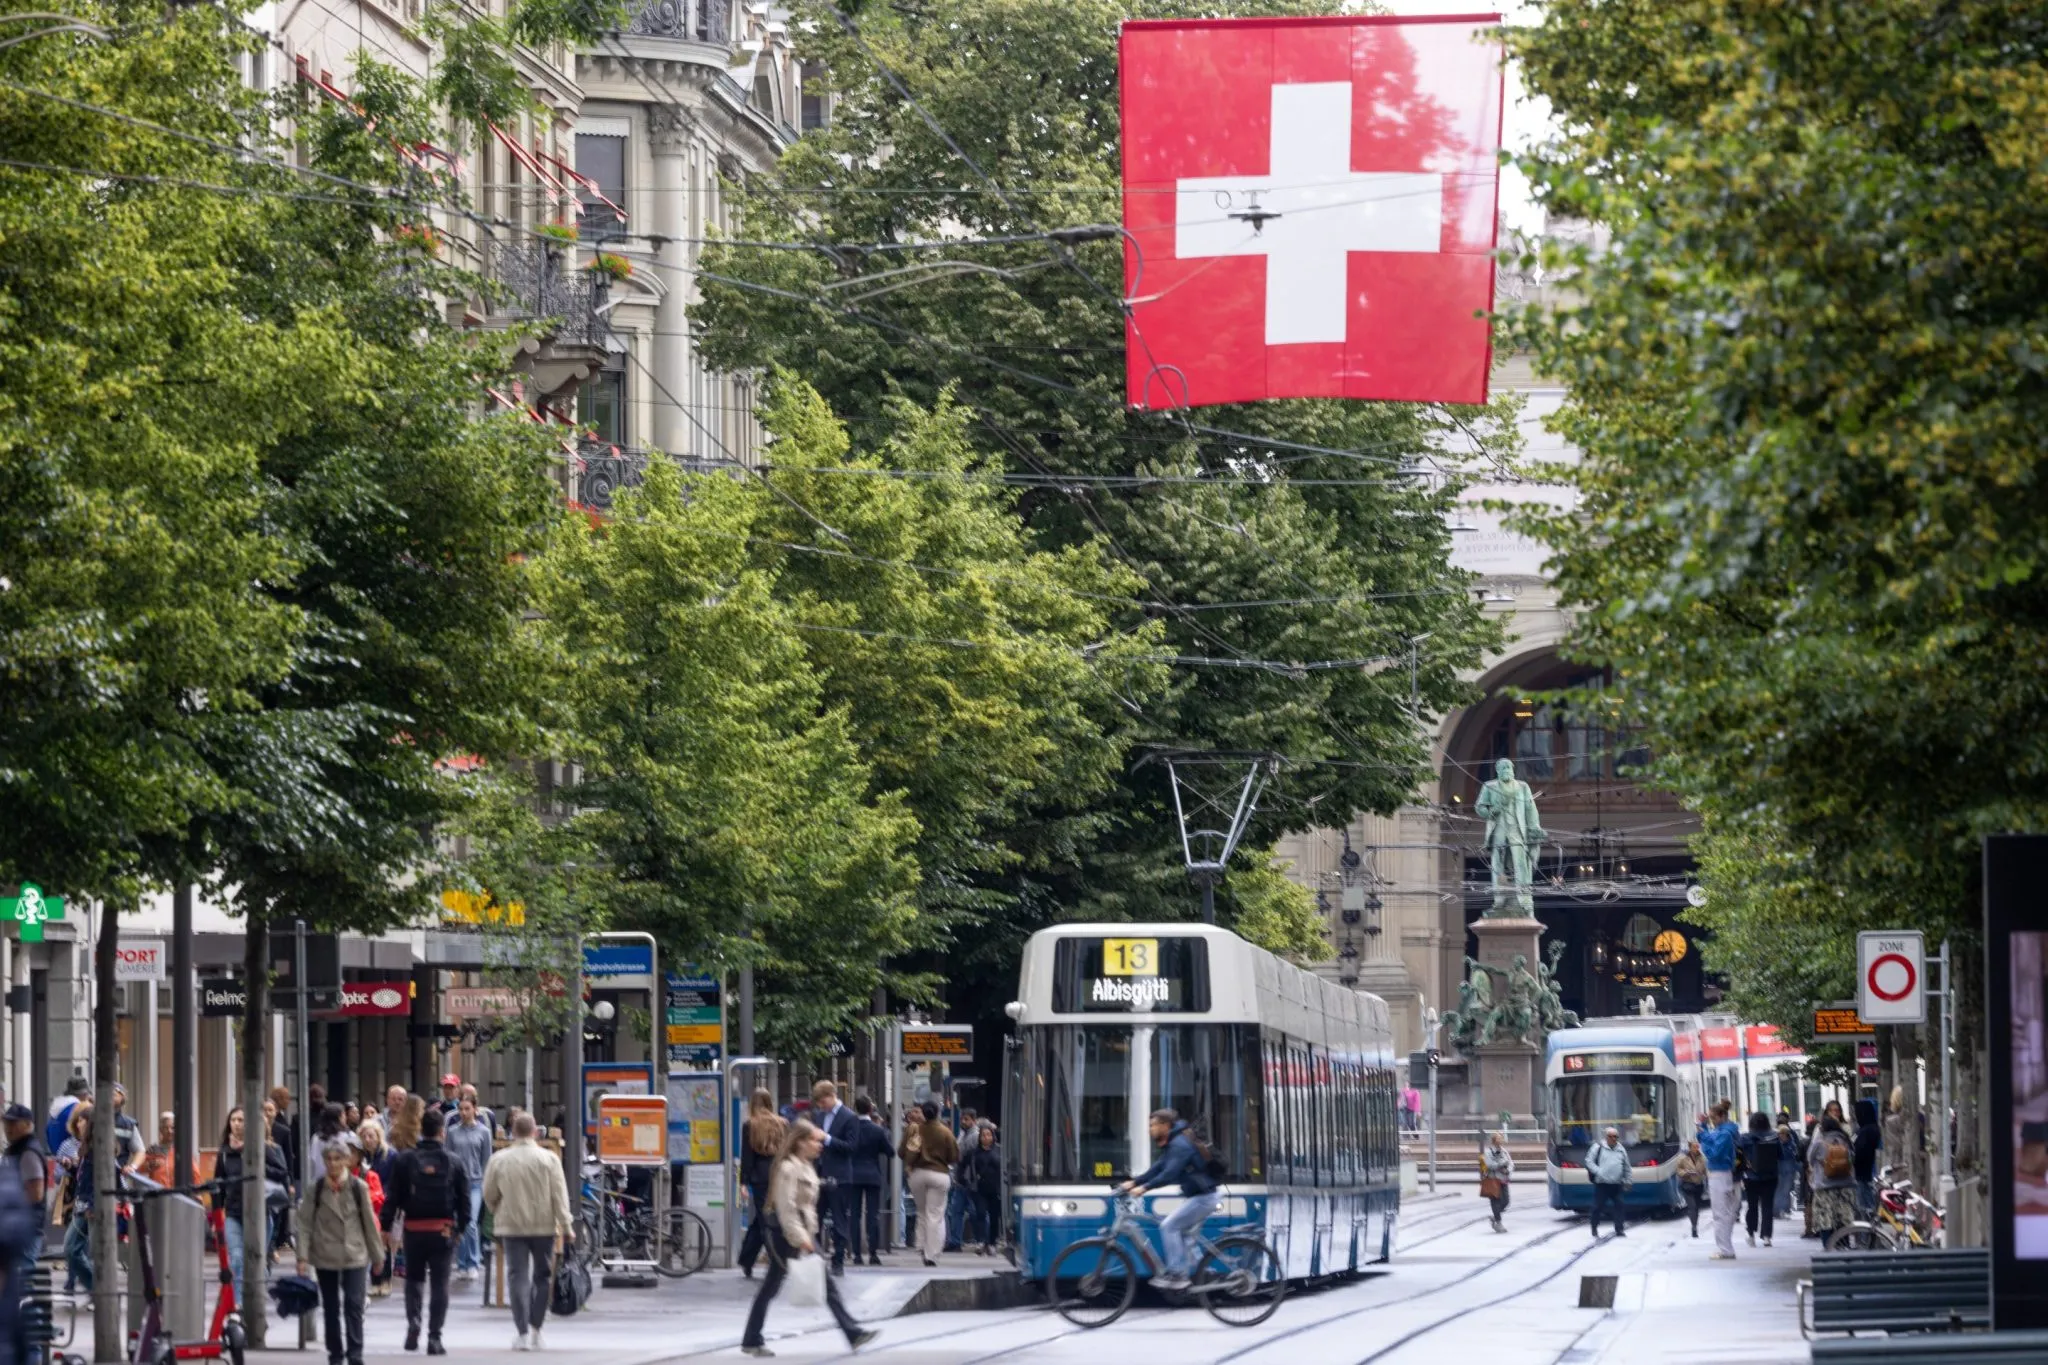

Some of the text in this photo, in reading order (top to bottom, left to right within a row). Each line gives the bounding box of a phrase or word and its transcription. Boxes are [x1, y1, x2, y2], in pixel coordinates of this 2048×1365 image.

[1879, 942, 1904, 952] ZONE
[116, 950, 156, 963] PORT
[1115, 944, 1147, 970] 13
[1093, 978, 1168, 1005] Albisgütli
[1568, 1057, 1583, 1069] 15
